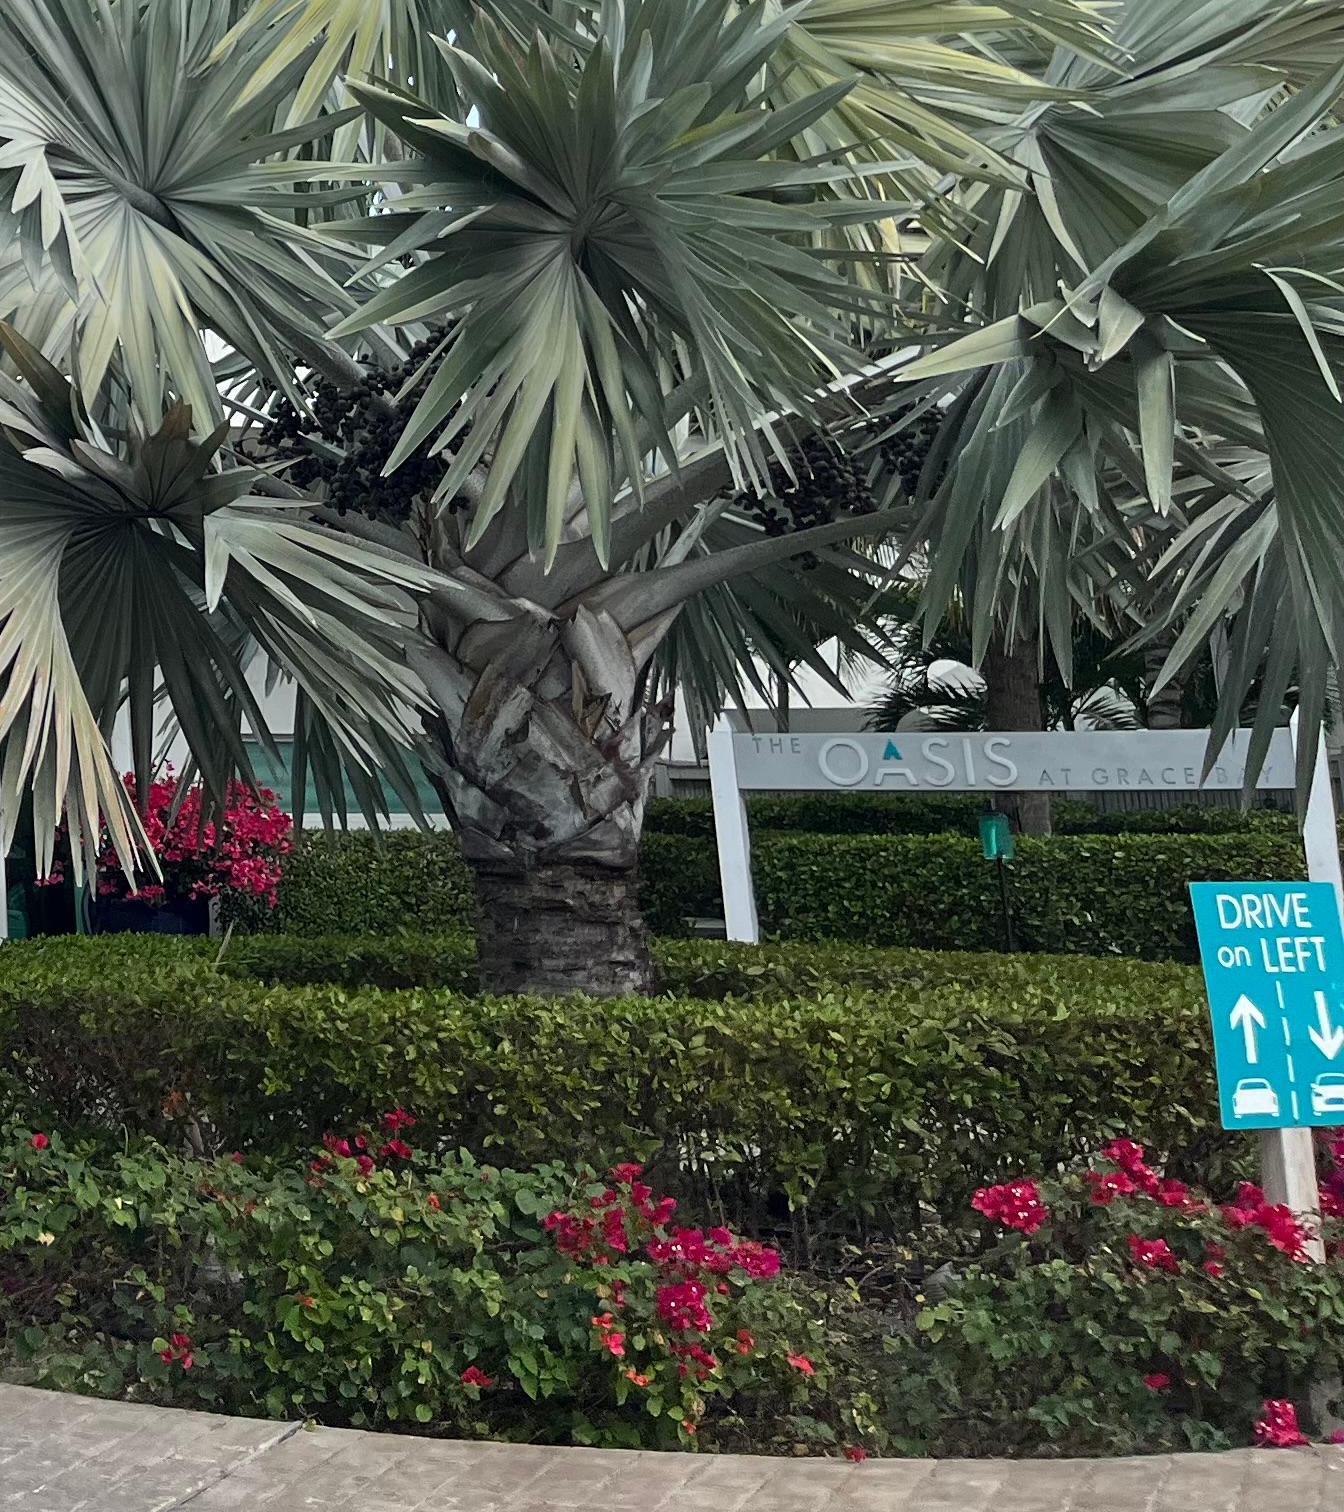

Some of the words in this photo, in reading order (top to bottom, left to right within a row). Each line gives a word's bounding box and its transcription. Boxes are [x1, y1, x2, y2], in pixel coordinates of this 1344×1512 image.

[752, 737, 801, 754] THE
[818, 738, 1018, 787] OASIS
[1038, 768, 1071, 786] AT
[1091, 767, 1196, 786] GRACE
[1216, 893, 1312, 929] DRIVE
[1217, 946, 1252, 968] on
[1260, 936, 1326, 973] LEFT
